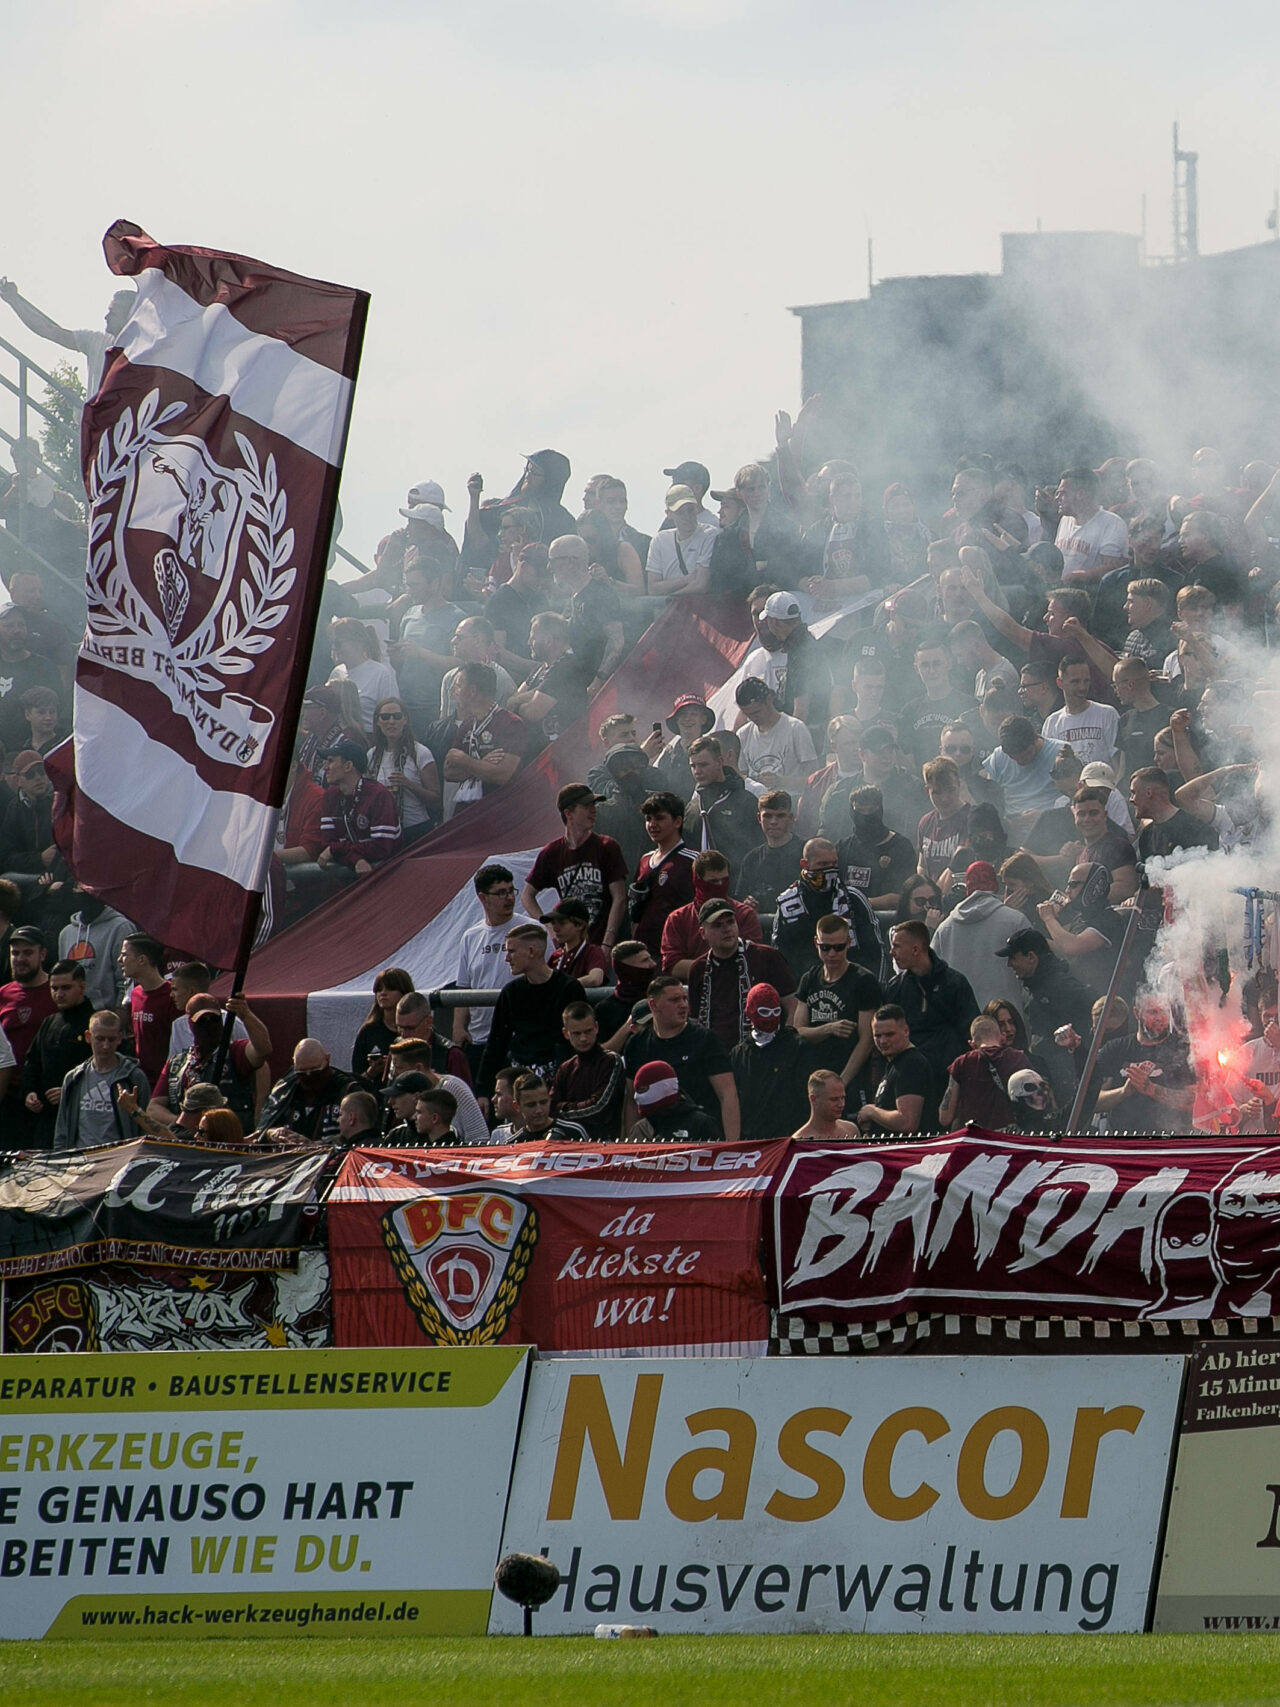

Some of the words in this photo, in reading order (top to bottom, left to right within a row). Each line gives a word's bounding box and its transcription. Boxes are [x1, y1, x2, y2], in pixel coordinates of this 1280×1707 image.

[404, 1195, 514, 1250] BFC
[599, 1206, 656, 1239] da
[785, 1153, 1190, 1289] BANDA
[151, 1247, 194, 1267] NICHT
[556, 1244, 702, 1281] kiekste
[9, 1284, 84, 1346] BFC
[592, 1288, 677, 1329] wa!
[1201, 1351, 1229, 1372] Ab
[1233, 1348, 1280, 1370] hier
[168, 1371, 452, 1397] BAUSTELLENSERVICE
[1199, 1379, 1223, 1397] 15
[545, 1372, 1146, 1522] Nascor
[37, 1482, 267, 1524] GENAUSO
[283, 1480, 415, 1521] HART
[189, 1535, 278, 1574] WIE
[294, 1534, 373, 1574] DU.
[532, 1545, 1121, 1632] Hausverwaltung
[81, 1602, 420, 1629] www.hack-werkzeughandel.de
